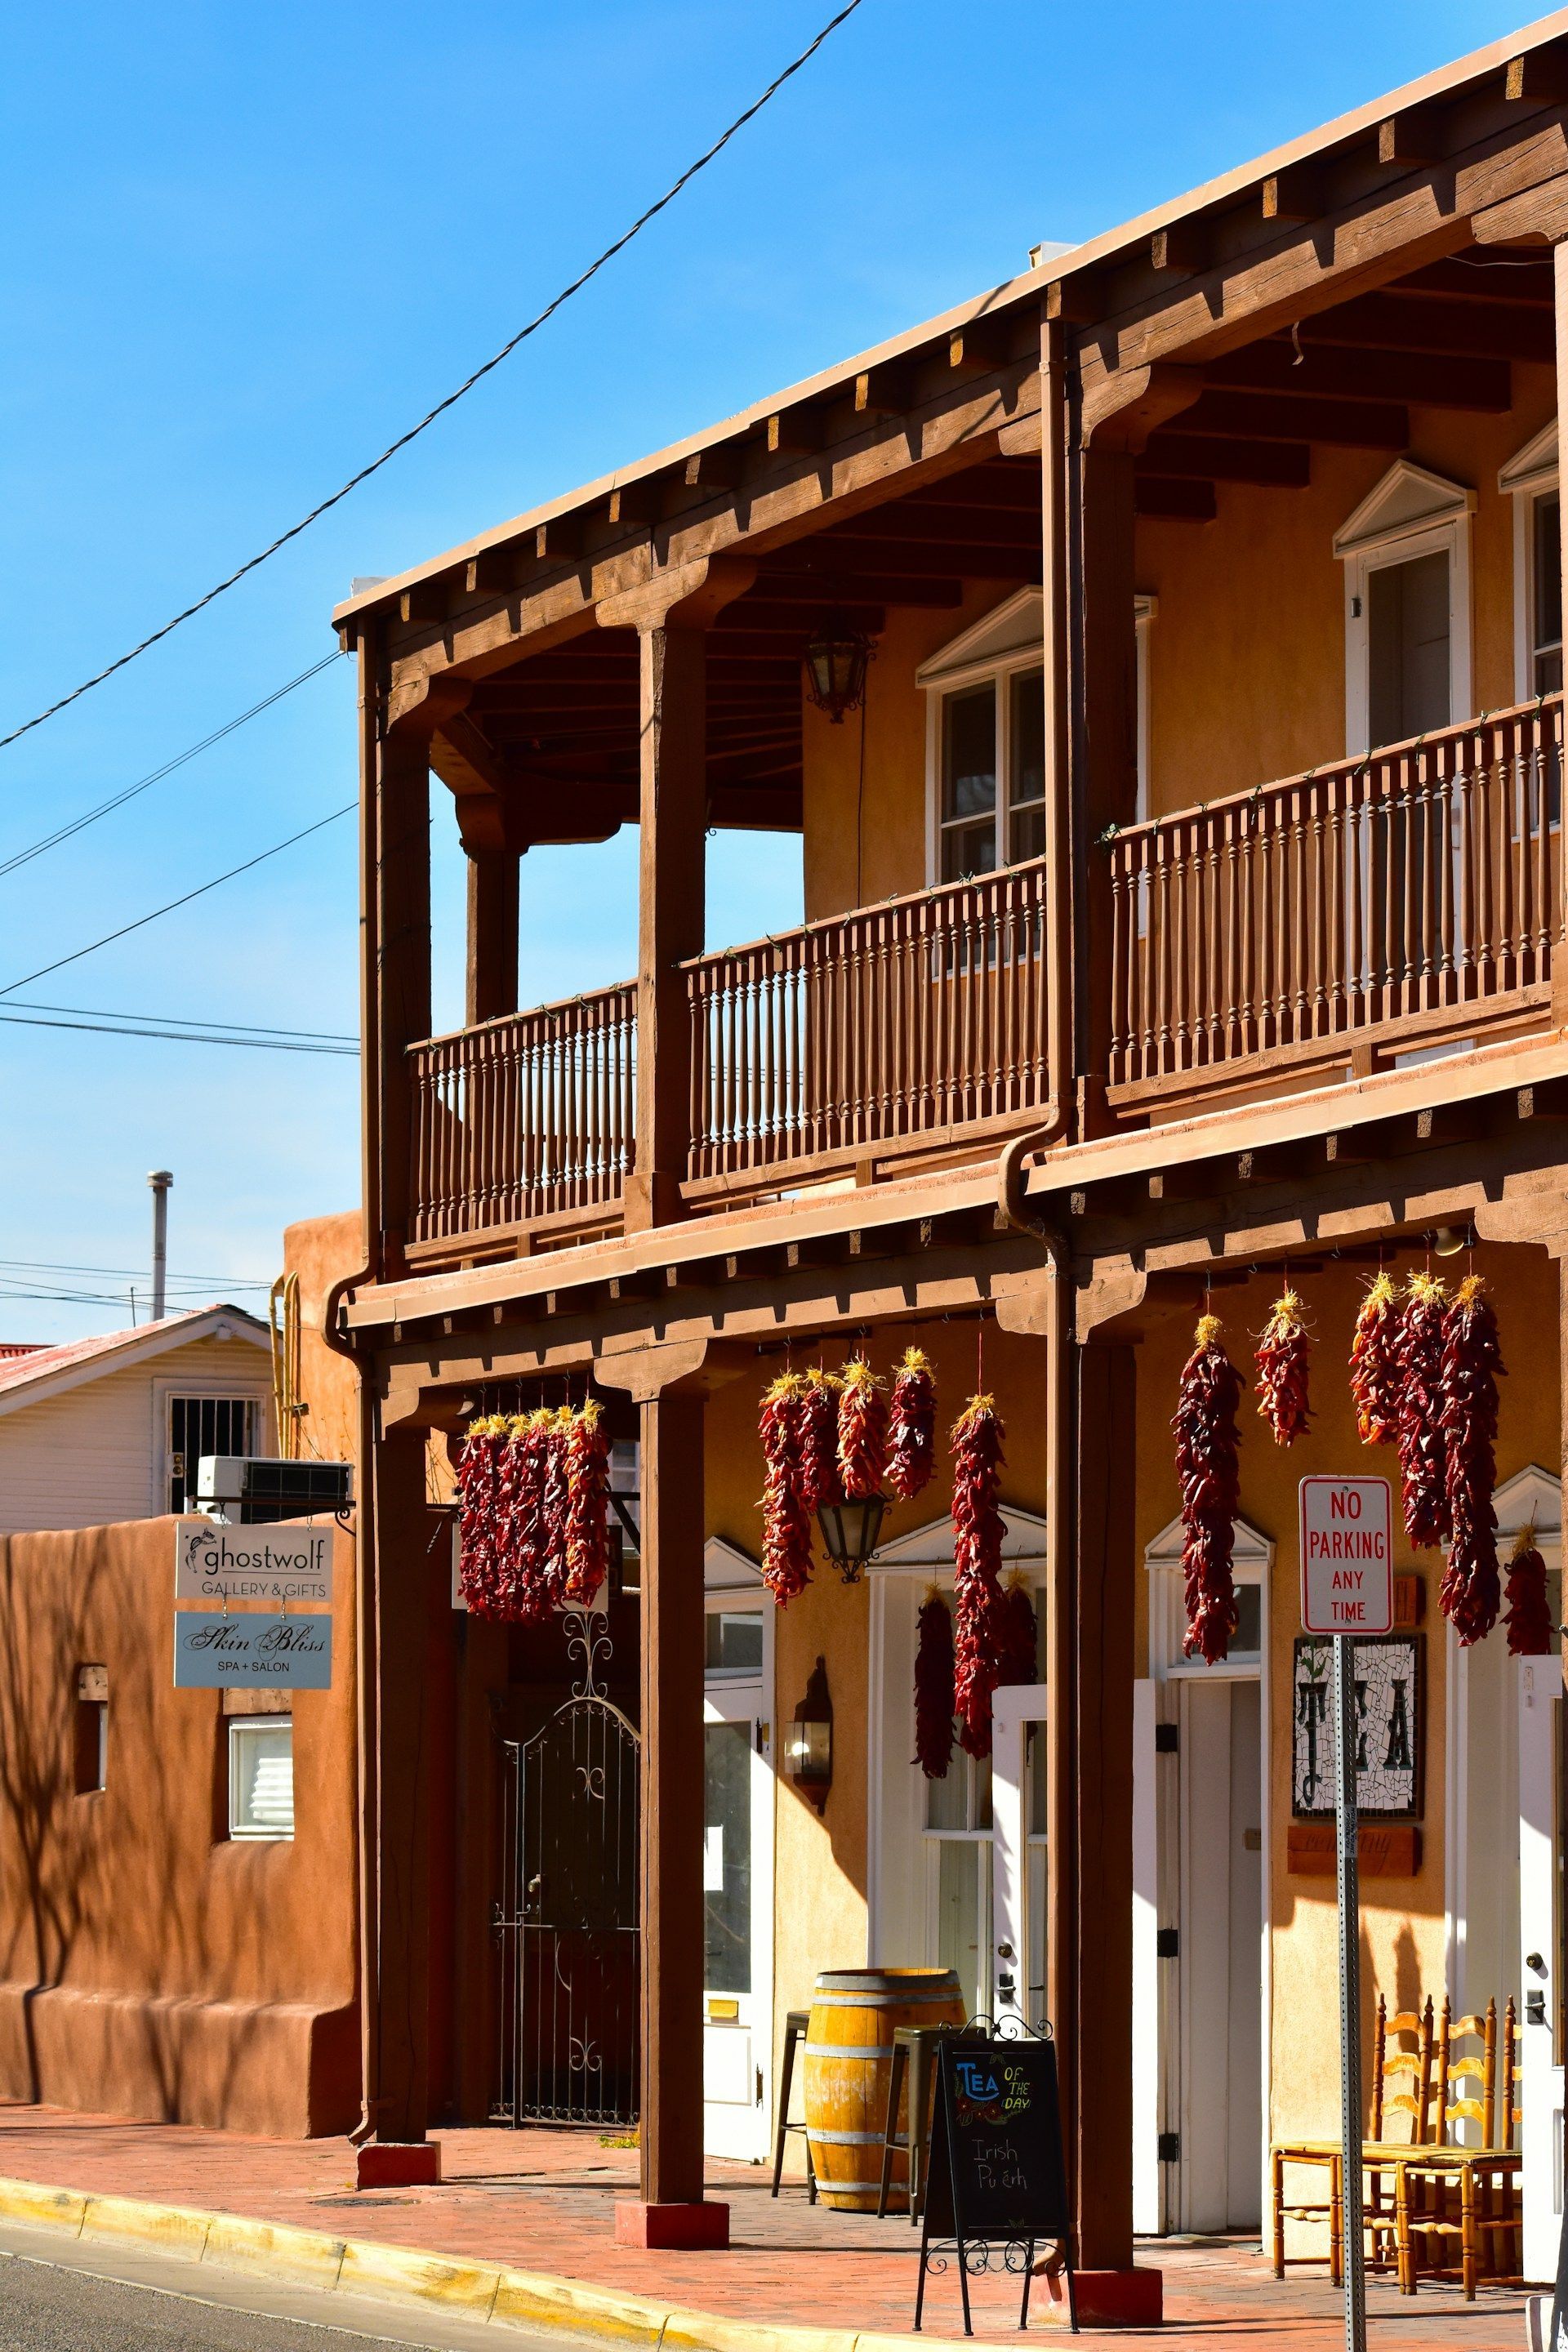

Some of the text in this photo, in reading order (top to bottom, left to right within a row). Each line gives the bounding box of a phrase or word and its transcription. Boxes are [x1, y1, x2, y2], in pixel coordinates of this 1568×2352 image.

[1331, 1491, 1361, 1519] NO
[1310, 1531, 1384, 1560] PARKING
[204, 1536, 325, 1575] ghostwolf
[202, 1581, 326, 1597] GALLERY & GIFTS
[1332, 1570, 1364, 1589] ANY
[1331, 1601, 1366, 1620] TIME
[183, 1623, 325, 1662] Skin Bliss
[217, 1661, 239, 1672] SPA
[252, 1661, 290, 1673] SALON
[956, 2063, 1000, 2101] TEA
[1004, 2067, 1024, 2081] OF
[1009, 2082, 1031, 2095] THE
[1004, 2097, 1030, 2109] DAY
[972, 2139, 1018, 2162] Irish
